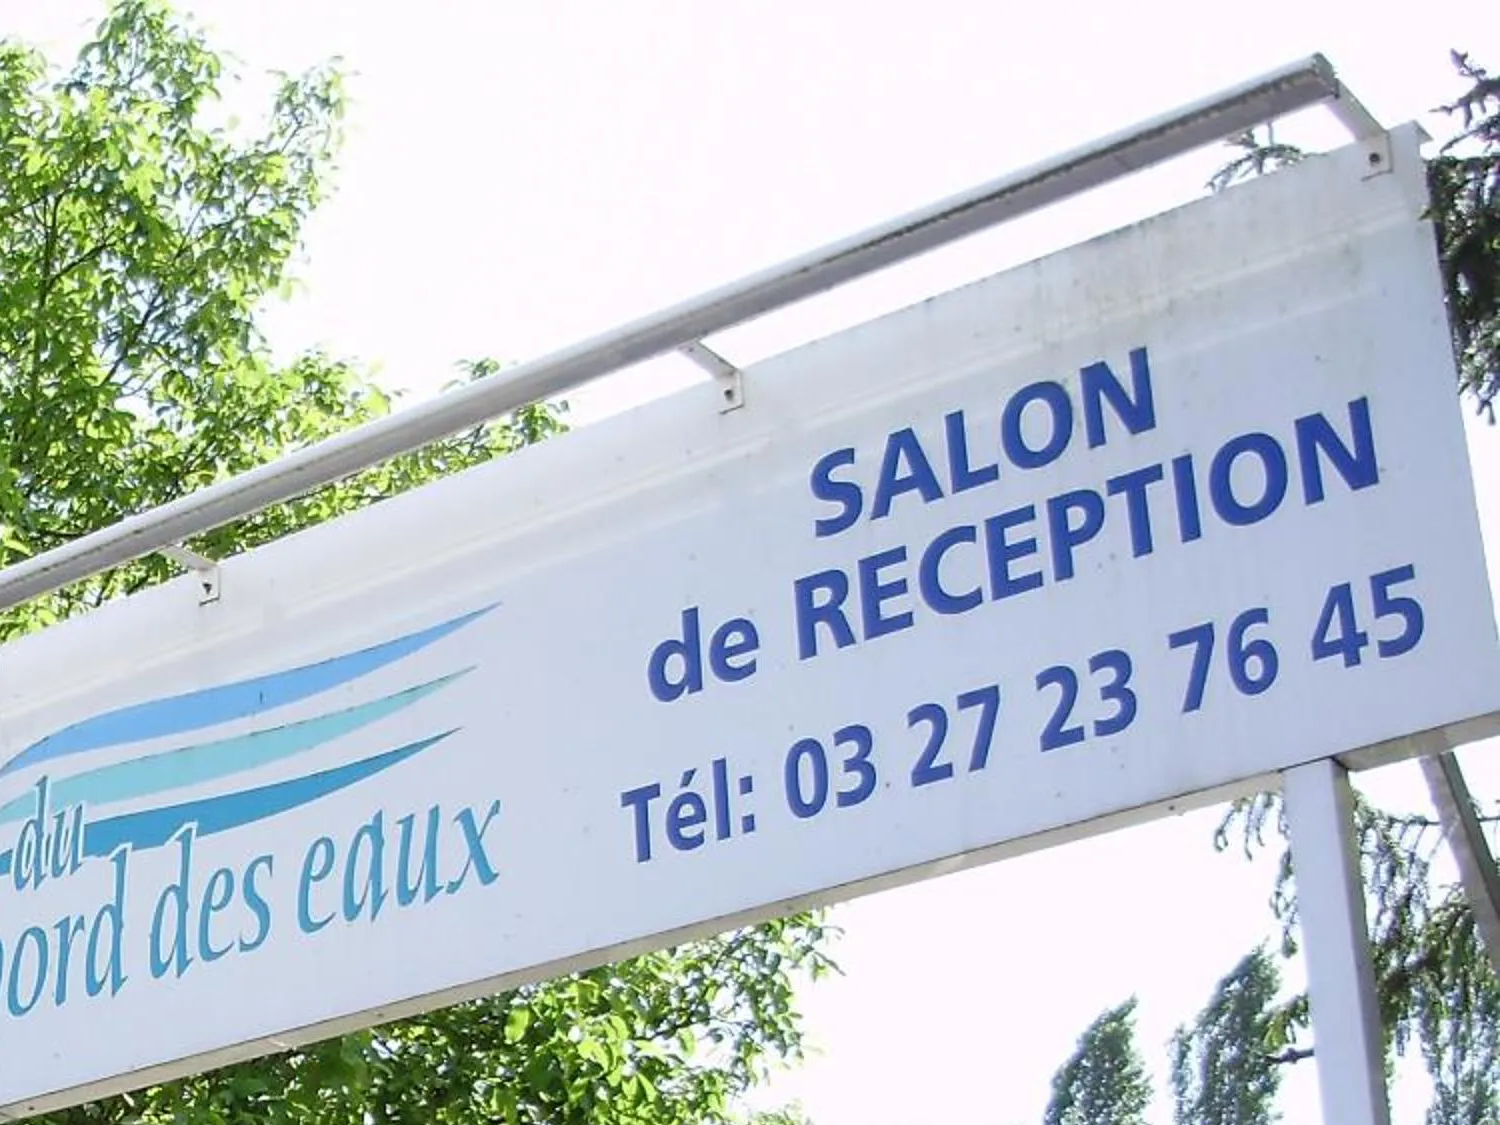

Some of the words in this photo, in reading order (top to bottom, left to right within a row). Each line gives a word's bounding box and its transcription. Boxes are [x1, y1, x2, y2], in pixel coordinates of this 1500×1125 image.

[811, 347, 1157, 537] SALON
[648, 607, 760, 703] de
[794, 397, 1380, 660] RECEPTION
[621, 757, 756, 864] Tél:
[784, 724, 877, 819] 03
[908, 685, 1000, 788] 27
[1036, 649, 1138, 752] 23
[1169, 608, 1279, 714] 76
[1311, 564, 1424, 668] 45
[13, 776, 85, 891] du
[150, 823, 274, 979] des
[298, 799, 501, 934] eaux
